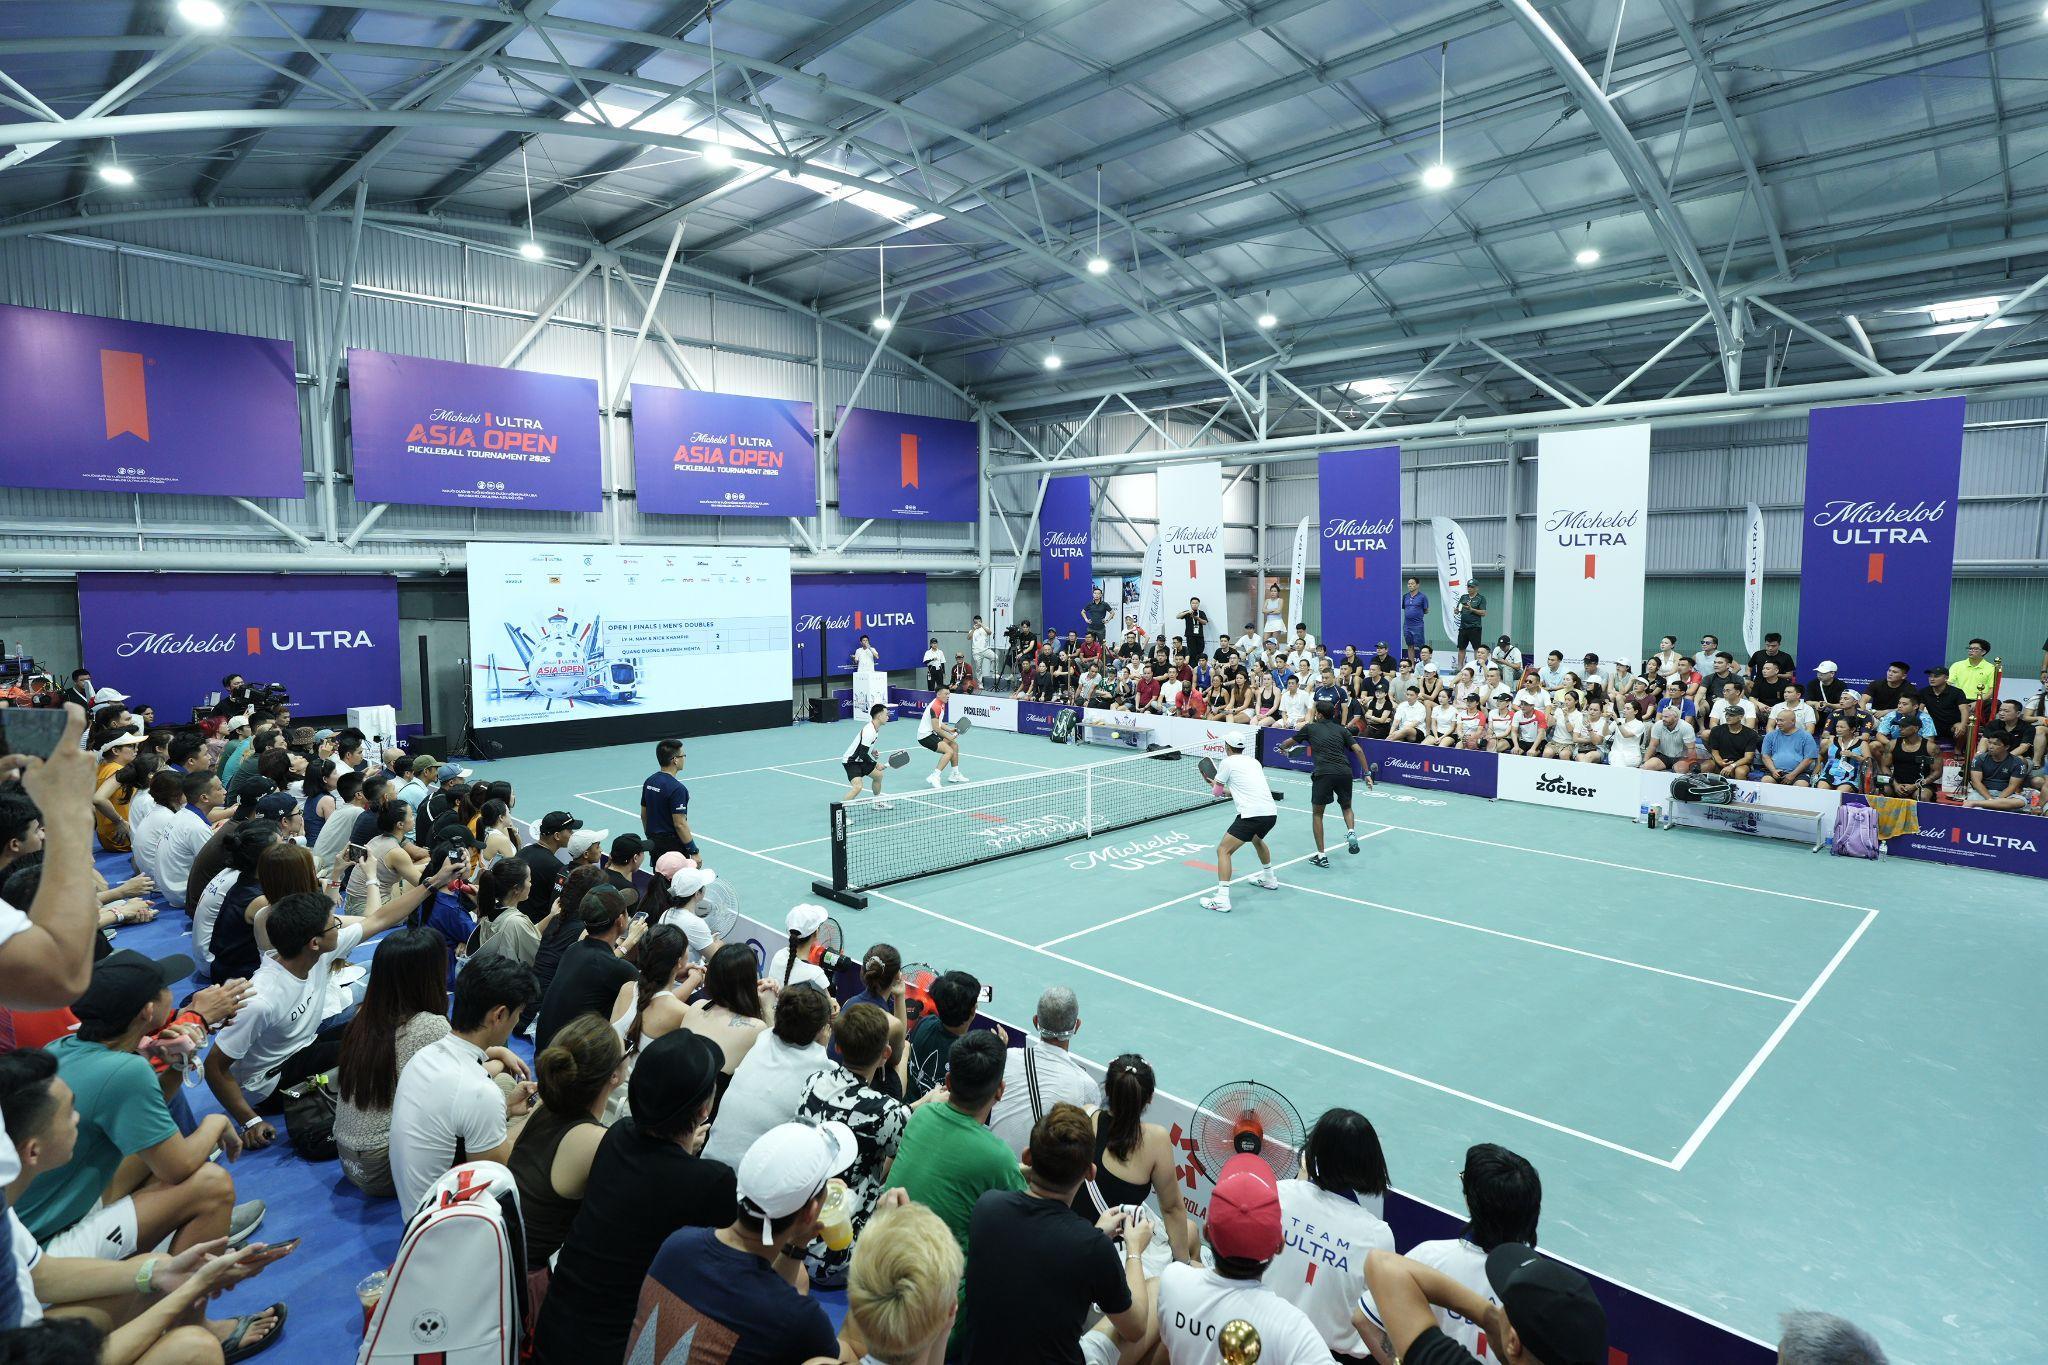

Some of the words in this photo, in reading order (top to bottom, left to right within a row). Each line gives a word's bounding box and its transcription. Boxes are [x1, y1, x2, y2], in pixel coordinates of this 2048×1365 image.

[430, 408, 481, 424] Michelob
[495, 415, 543, 430] ULTRA
[483, 429, 559, 454] OPEN
[690, 431, 727, 445] Michelob
[738, 436, 773, 448] ULTRA
[407, 445, 464, 457] PICKLEBALL
[466, 449, 528, 462] TOURNAMENT
[528, 454, 551, 463] 2026
[729, 448, 784, 468] OPEN
[674, 463, 716, 473] PICKLEBALL
[717, 466, 762, 475] TOURNAMENT
[1544, 509, 1639, 532] Michelob
[1813, 500, 1947, 527] Michelob
[1165, 525, 1218, 542] Michelob
[1323, 518, 1395, 538] Michelob
[1832, 527, 1931, 545] ULTRA
[1043, 531, 1088, 547] Michelob
[1173, 543, 1213, 555] ULTRA
[1334, 538, 1387, 552] ULTRA
[1558, 532, 1627, 547] ULTRA
[1050, 547, 1084, 558] ULTRA
[1446, 531, 1458, 577] ULTRA
[796, 613, 851, 633] Mihelob
[866, 612, 915, 628] ULTRA
[116, 631, 237, 657] Michelob
[271, 630, 373, 651] ULTRA
[537, 666, 558, 674] ASIA
[560, 665, 584, 673] OPEN
[963, 706, 991, 718] PICKLEBALL
[1384, 756, 1422, 770] Michelob
[1432, 763, 1471, 777] ULTRA
[1536, 779, 1597, 798] zocker
[1064, 830, 1190, 870] Michelob
[1966, 832, 2037, 853] ULTRA
[1109, 842, 1215, 871] ULTRA
[1291, 1216, 1350, 1250] TEAM
[1283, 1230, 1349, 1273] ULTRA
